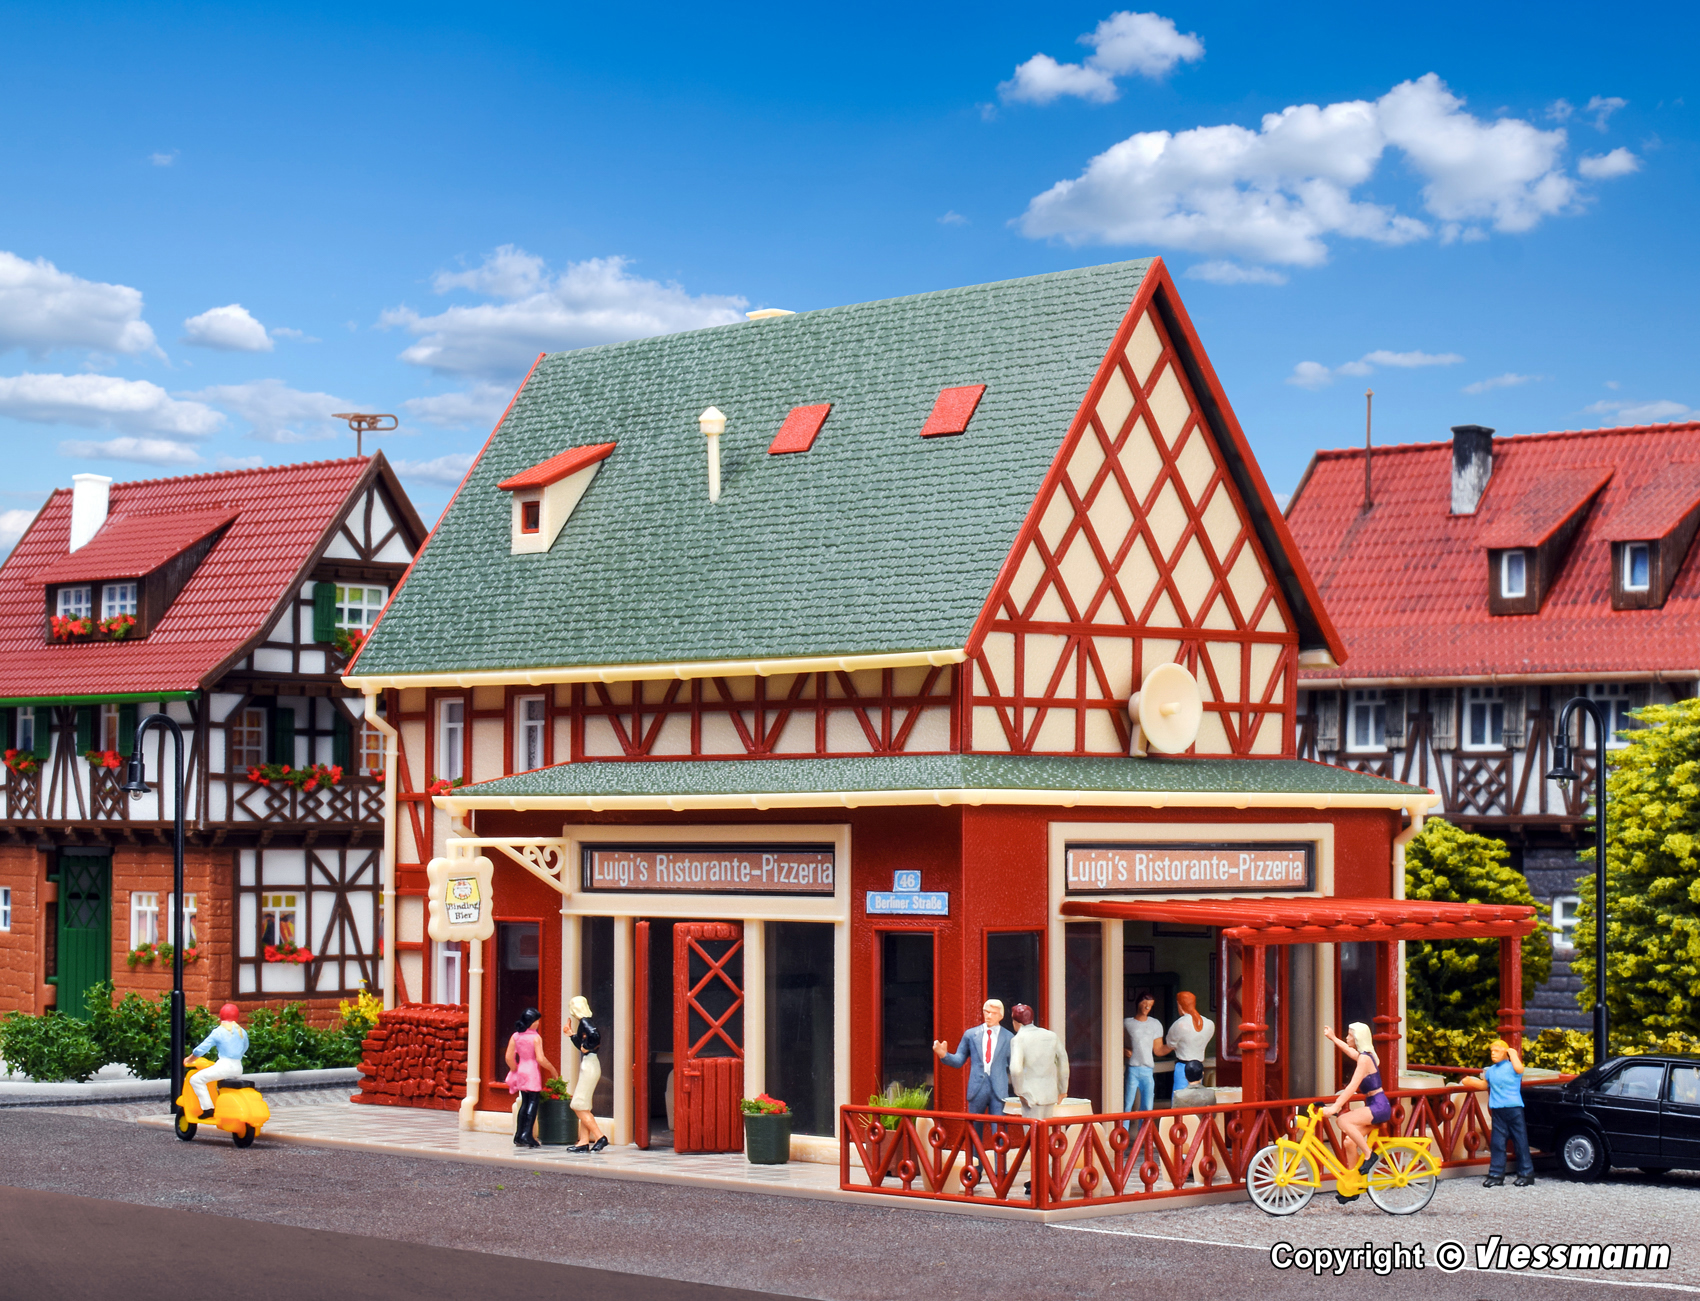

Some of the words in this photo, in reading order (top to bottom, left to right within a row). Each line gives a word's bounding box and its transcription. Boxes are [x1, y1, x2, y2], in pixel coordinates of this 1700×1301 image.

[594, 852, 648, 887] Luigi's
[656, 854, 833, 884] Ristorante-Pizzeria
[1068, 852, 1127, 888] Luigi's
[1135, 853, 1303, 882] Ristorante-Pizzeria
[900, 874, 915, 888] 46
[875, 895, 910, 910] Berliner
[912, 895, 942, 910] Straße
[455, 911, 472, 920] Bier
